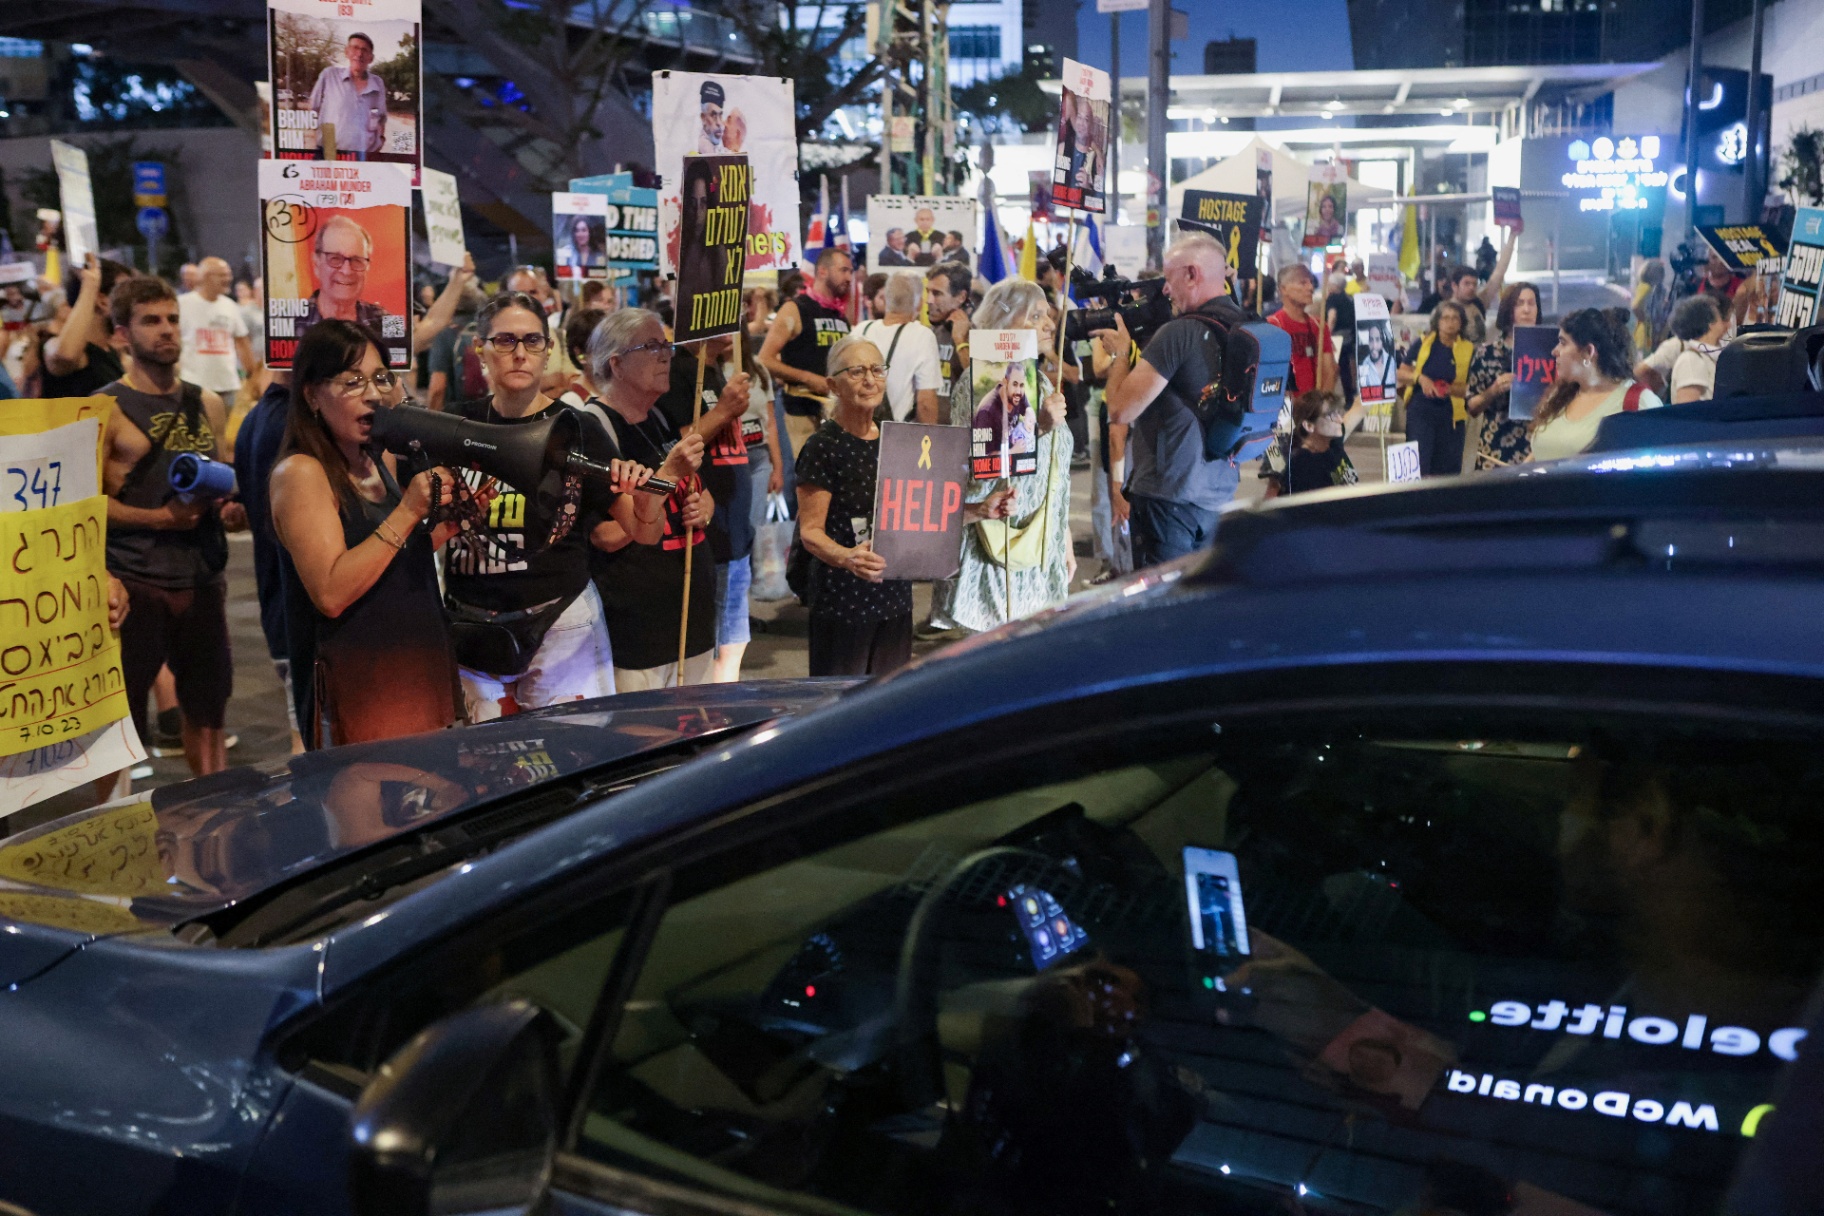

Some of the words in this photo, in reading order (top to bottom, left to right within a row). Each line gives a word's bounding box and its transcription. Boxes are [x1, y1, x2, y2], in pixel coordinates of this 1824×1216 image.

[277, 109, 318, 129] BRING
[279, 130, 305, 149] HIM
[300, 180, 337, 191] ABRAHAM
[340, 181, 372, 192] MUNDER
[719, 164, 747, 203] אמא
[622, 207, 657, 231] THE
[1198, 197, 1248, 222] HOSTAGE
[705, 204, 746, 247] לעולם
[724, 245, 743, 285] לא
[269, 298, 309, 317] BRING
[690, 288, 740, 331] מוותרת
[269, 317, 295, 337] HIM
[270, 340, 300, 359] HOM
[1517, 354, 1559, 383] צילו
[1261, 381, 1280, 393] LiveU
[972, 427, 993, 443] BRING
[973, 442, 986, 457] HIM
[973, 457, 991, 472] HOME
[7, 461, 62, 511] 347
[880, 477, 961, 532] HELP
